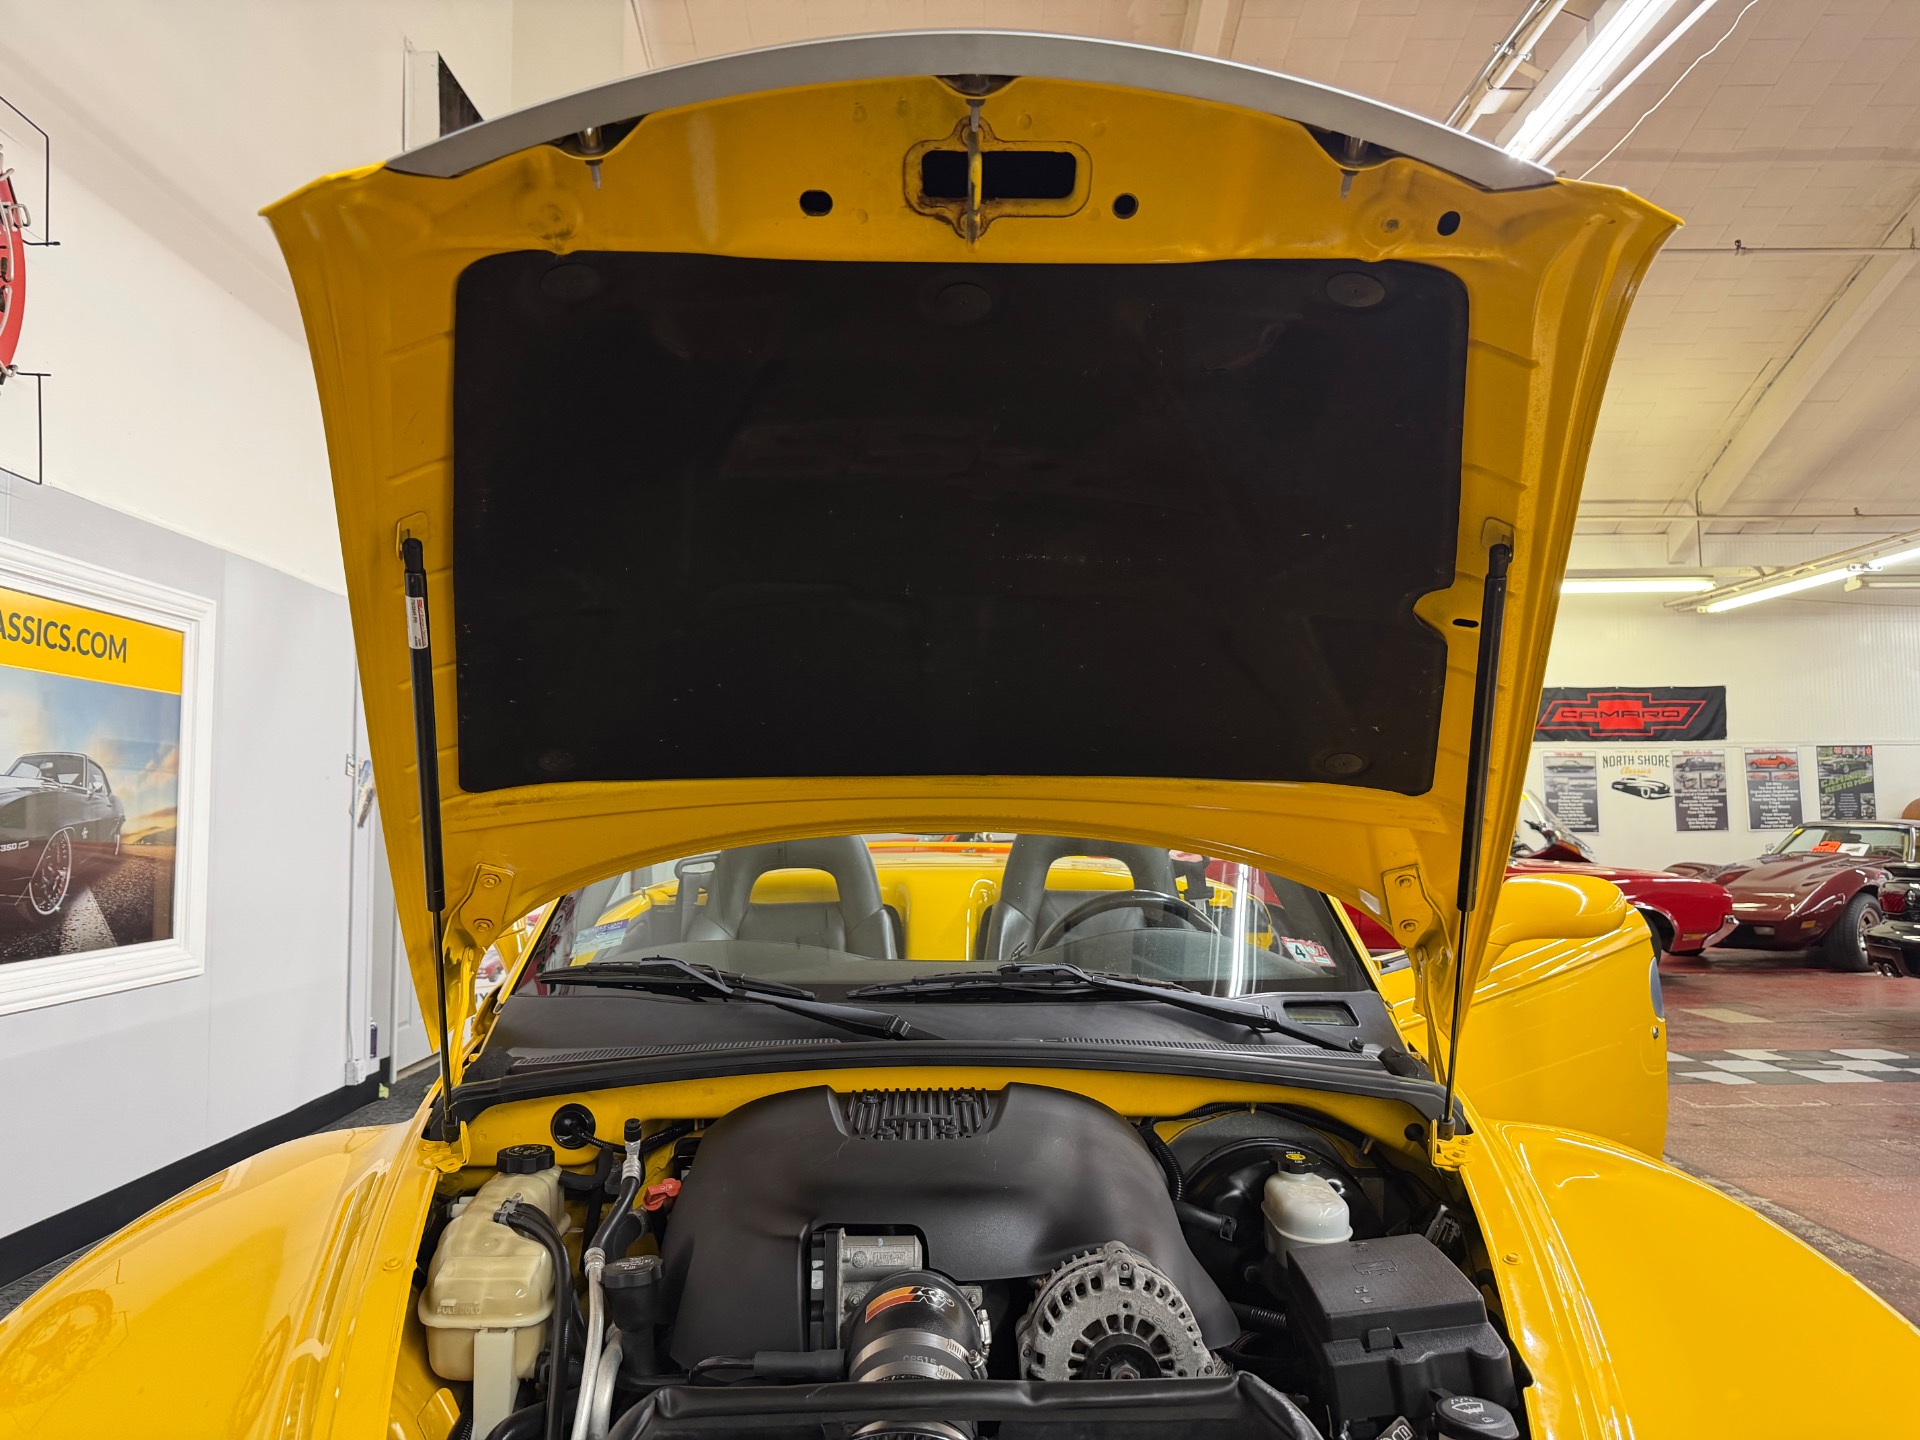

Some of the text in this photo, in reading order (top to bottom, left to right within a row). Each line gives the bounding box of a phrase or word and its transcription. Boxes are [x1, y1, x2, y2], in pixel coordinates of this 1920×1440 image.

[1561, 710, 1680, 719] CAMARO
[1602, 754, 1671, 769] NORTH SHORE
[1295, 945, 1306, 959] 4
